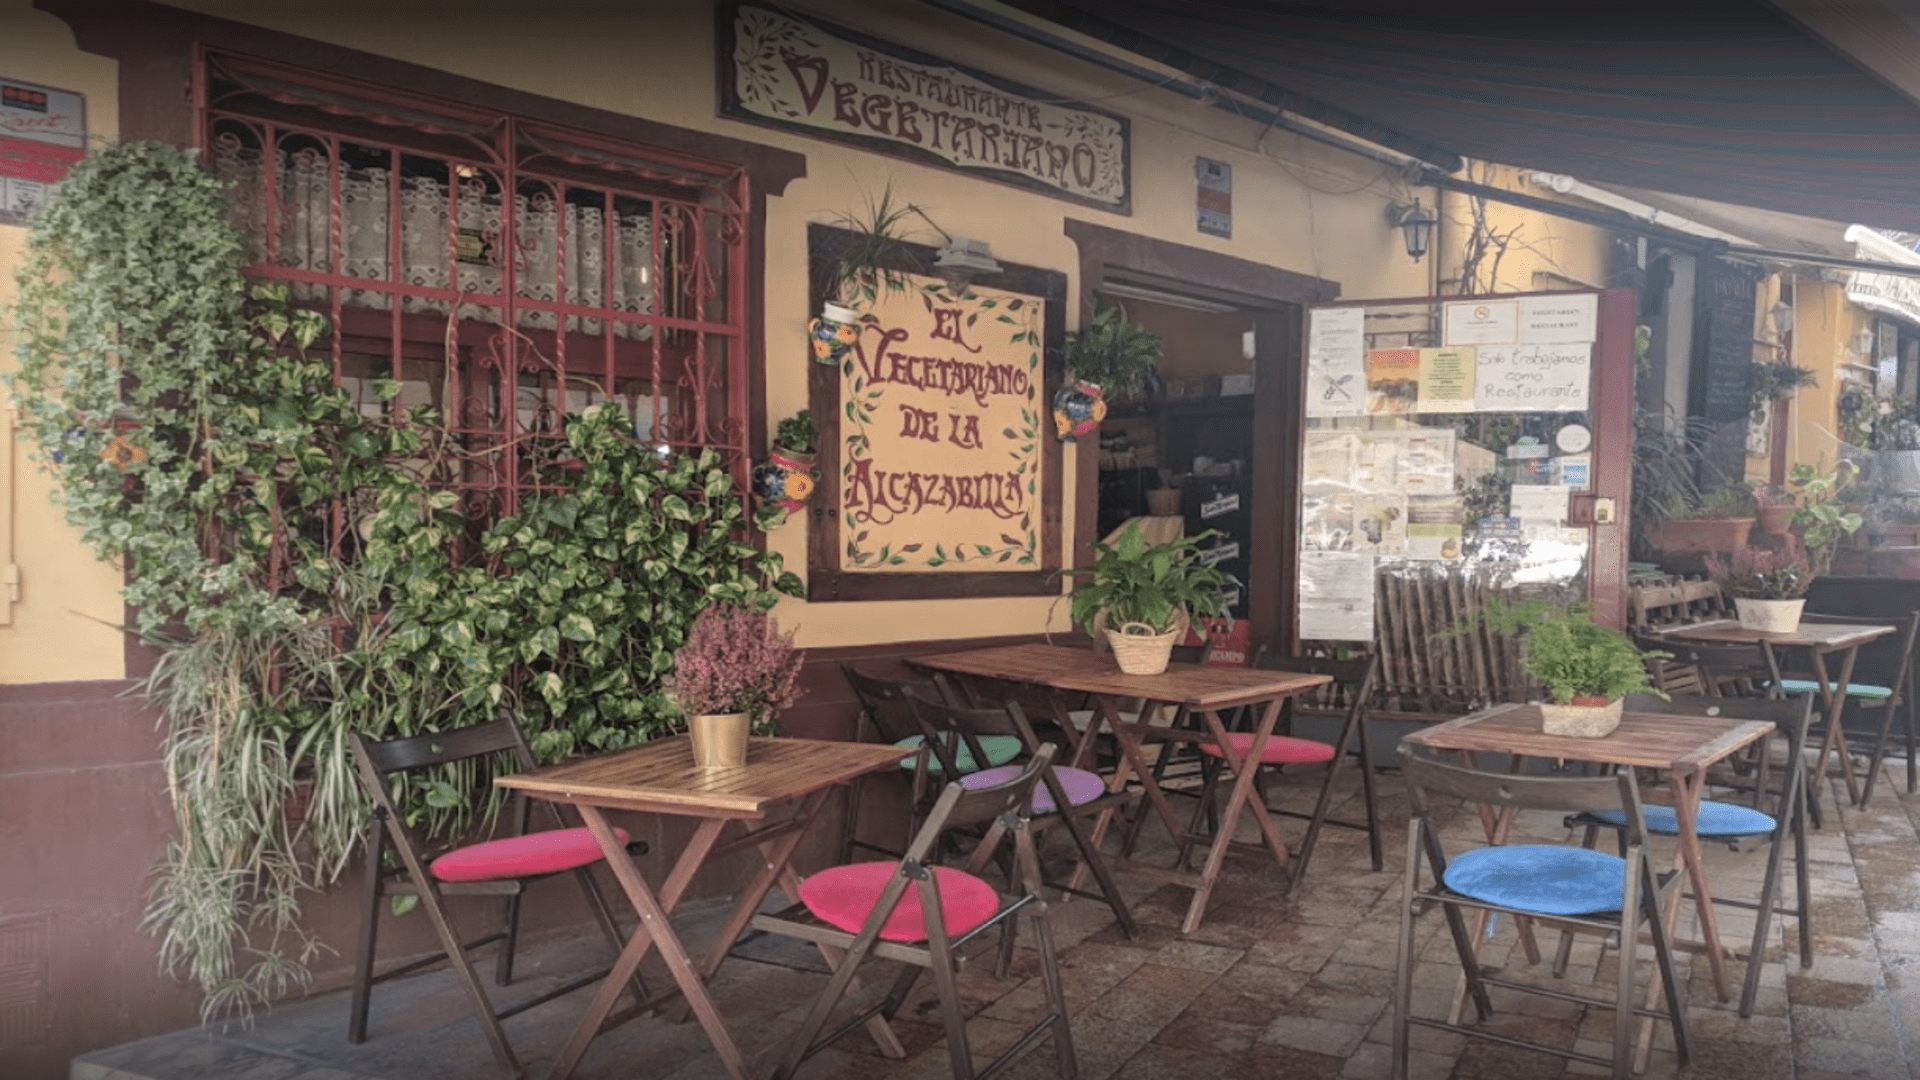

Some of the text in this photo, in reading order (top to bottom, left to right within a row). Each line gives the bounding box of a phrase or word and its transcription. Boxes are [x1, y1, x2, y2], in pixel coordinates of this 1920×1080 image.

[855, 51, 1042, 133] RESTAURANTE
[778, 45, 1095, 188] VEGETARIANO
[1504, 371, 1544, 381] como
[1511, 345, 1587, 370] trabajamos
[1483, 380, 1582, 398] Restaurante
[899, 403, 984, 450] DE LA
[844, 444, 1026, 525] ALCAZABILLA
